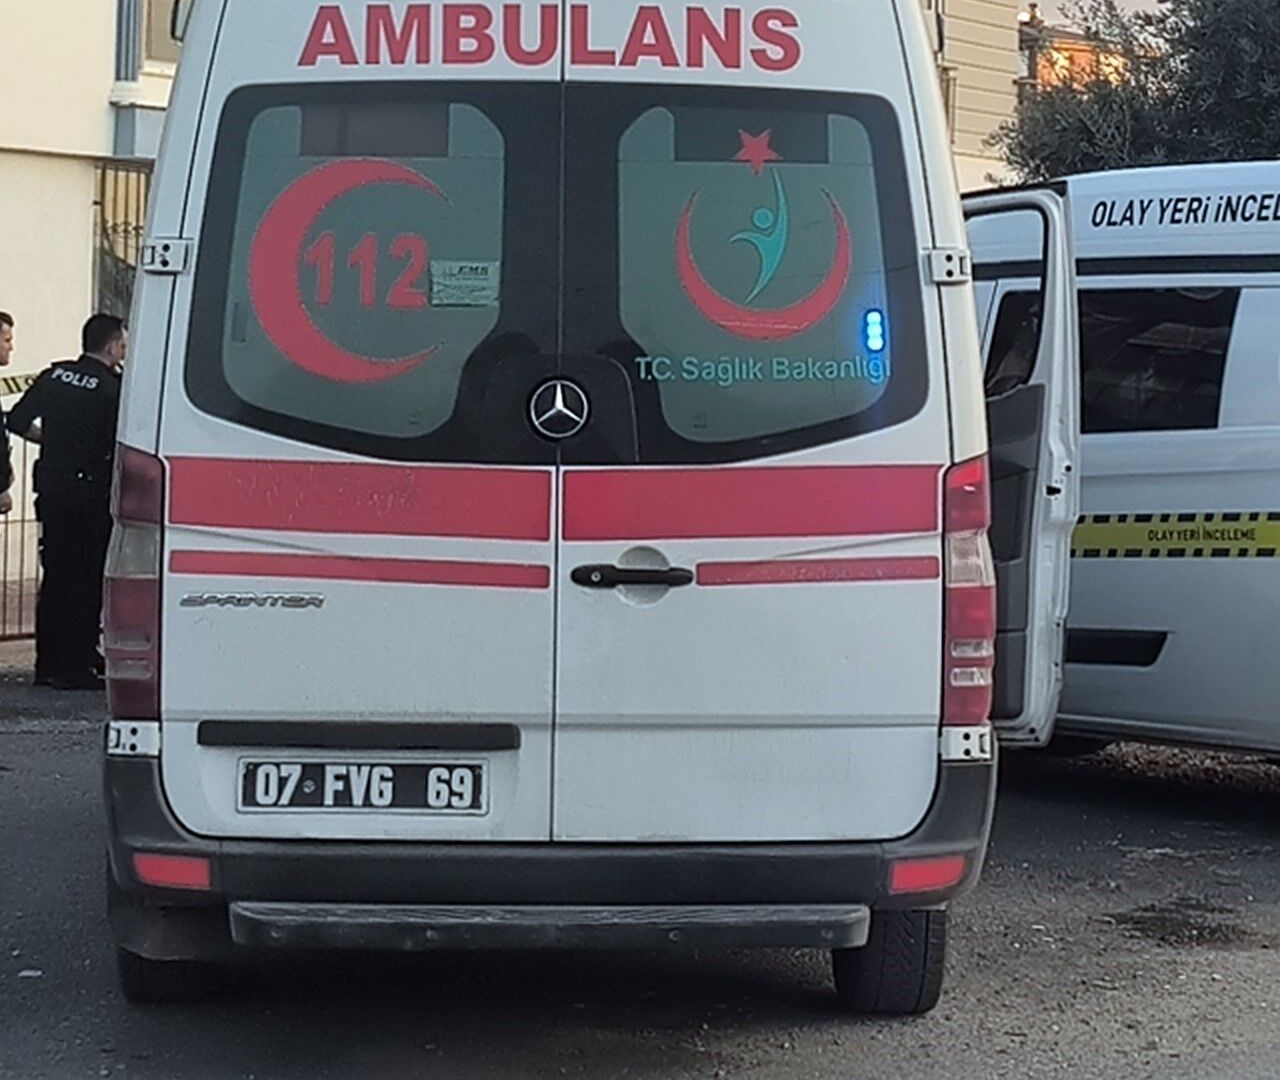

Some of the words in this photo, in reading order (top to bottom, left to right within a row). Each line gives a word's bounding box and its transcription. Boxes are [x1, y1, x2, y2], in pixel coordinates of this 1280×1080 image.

[297, 3, 802, 72] AMBULANS
[1091, 199, 1152, 227] OLAY
[305, 232, 429, 309] 112
[634, 357, 675, 380] T.C.
[681, 356, 763, 386] Sağlık
[772, 356, 891, 385] Bakanlığı
[1147, 528, 1174, 541] OLAY
[180, 592, 326, 609] SPRINTER
[255, 764, 302, 806] 07
[323, 766, 393, 807] FVG
[426, 767, 473, 809] 69
